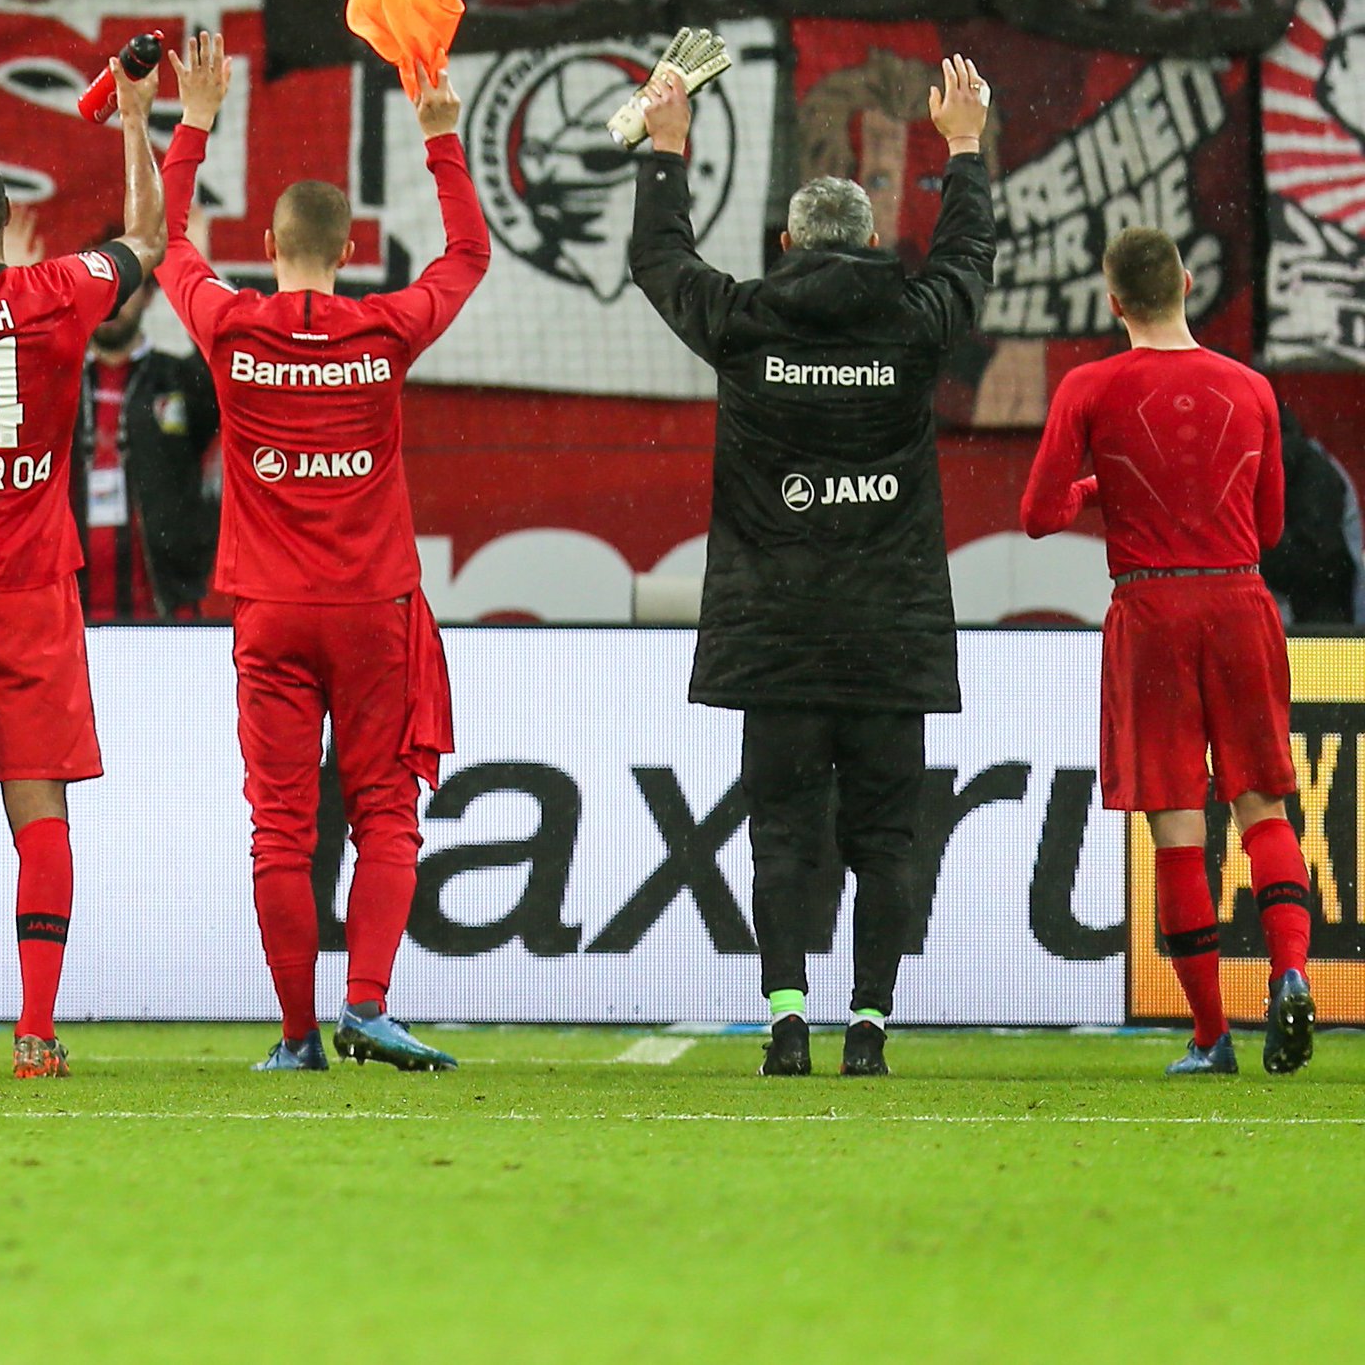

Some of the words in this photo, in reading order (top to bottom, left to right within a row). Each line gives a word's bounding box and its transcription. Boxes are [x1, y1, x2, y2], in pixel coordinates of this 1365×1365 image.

[230, 350, 392, 387] Barmenia
[765, 355, 896, 386] Barmenia
[11, 450, 53, 491] 04
[293, 448, 374, 478] JAKO
[820, 473, 900, 505] JAKO
